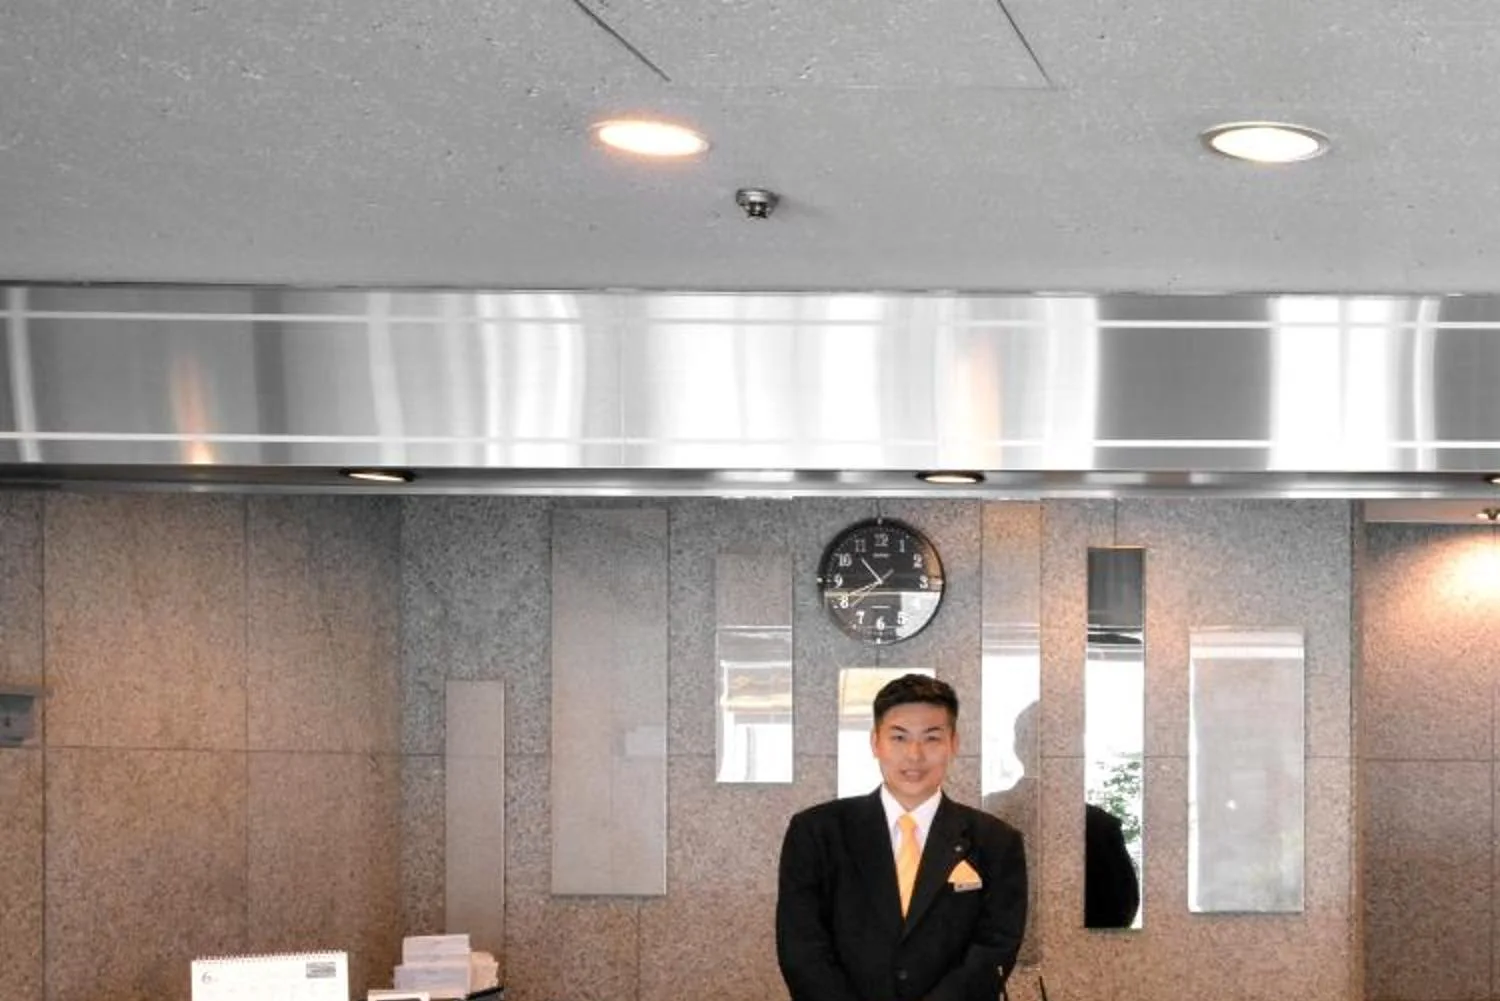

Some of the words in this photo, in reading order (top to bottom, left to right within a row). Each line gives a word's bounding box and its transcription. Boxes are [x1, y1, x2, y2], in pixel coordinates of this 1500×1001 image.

[855, 539, 867, 553] 11
[873, 533, 889, 547] 12
[899, 539, 905, 553] 1
[838, 552, 852, 567] 10
[914, 553, 923, 568] 2
[834, 574, 843, 588] 9
[919, 575, 929, 589] 3
[855, 611, 866, 625] 7
[875, 616, 885, 630] 6
[898, 611, 907, 625] 5
